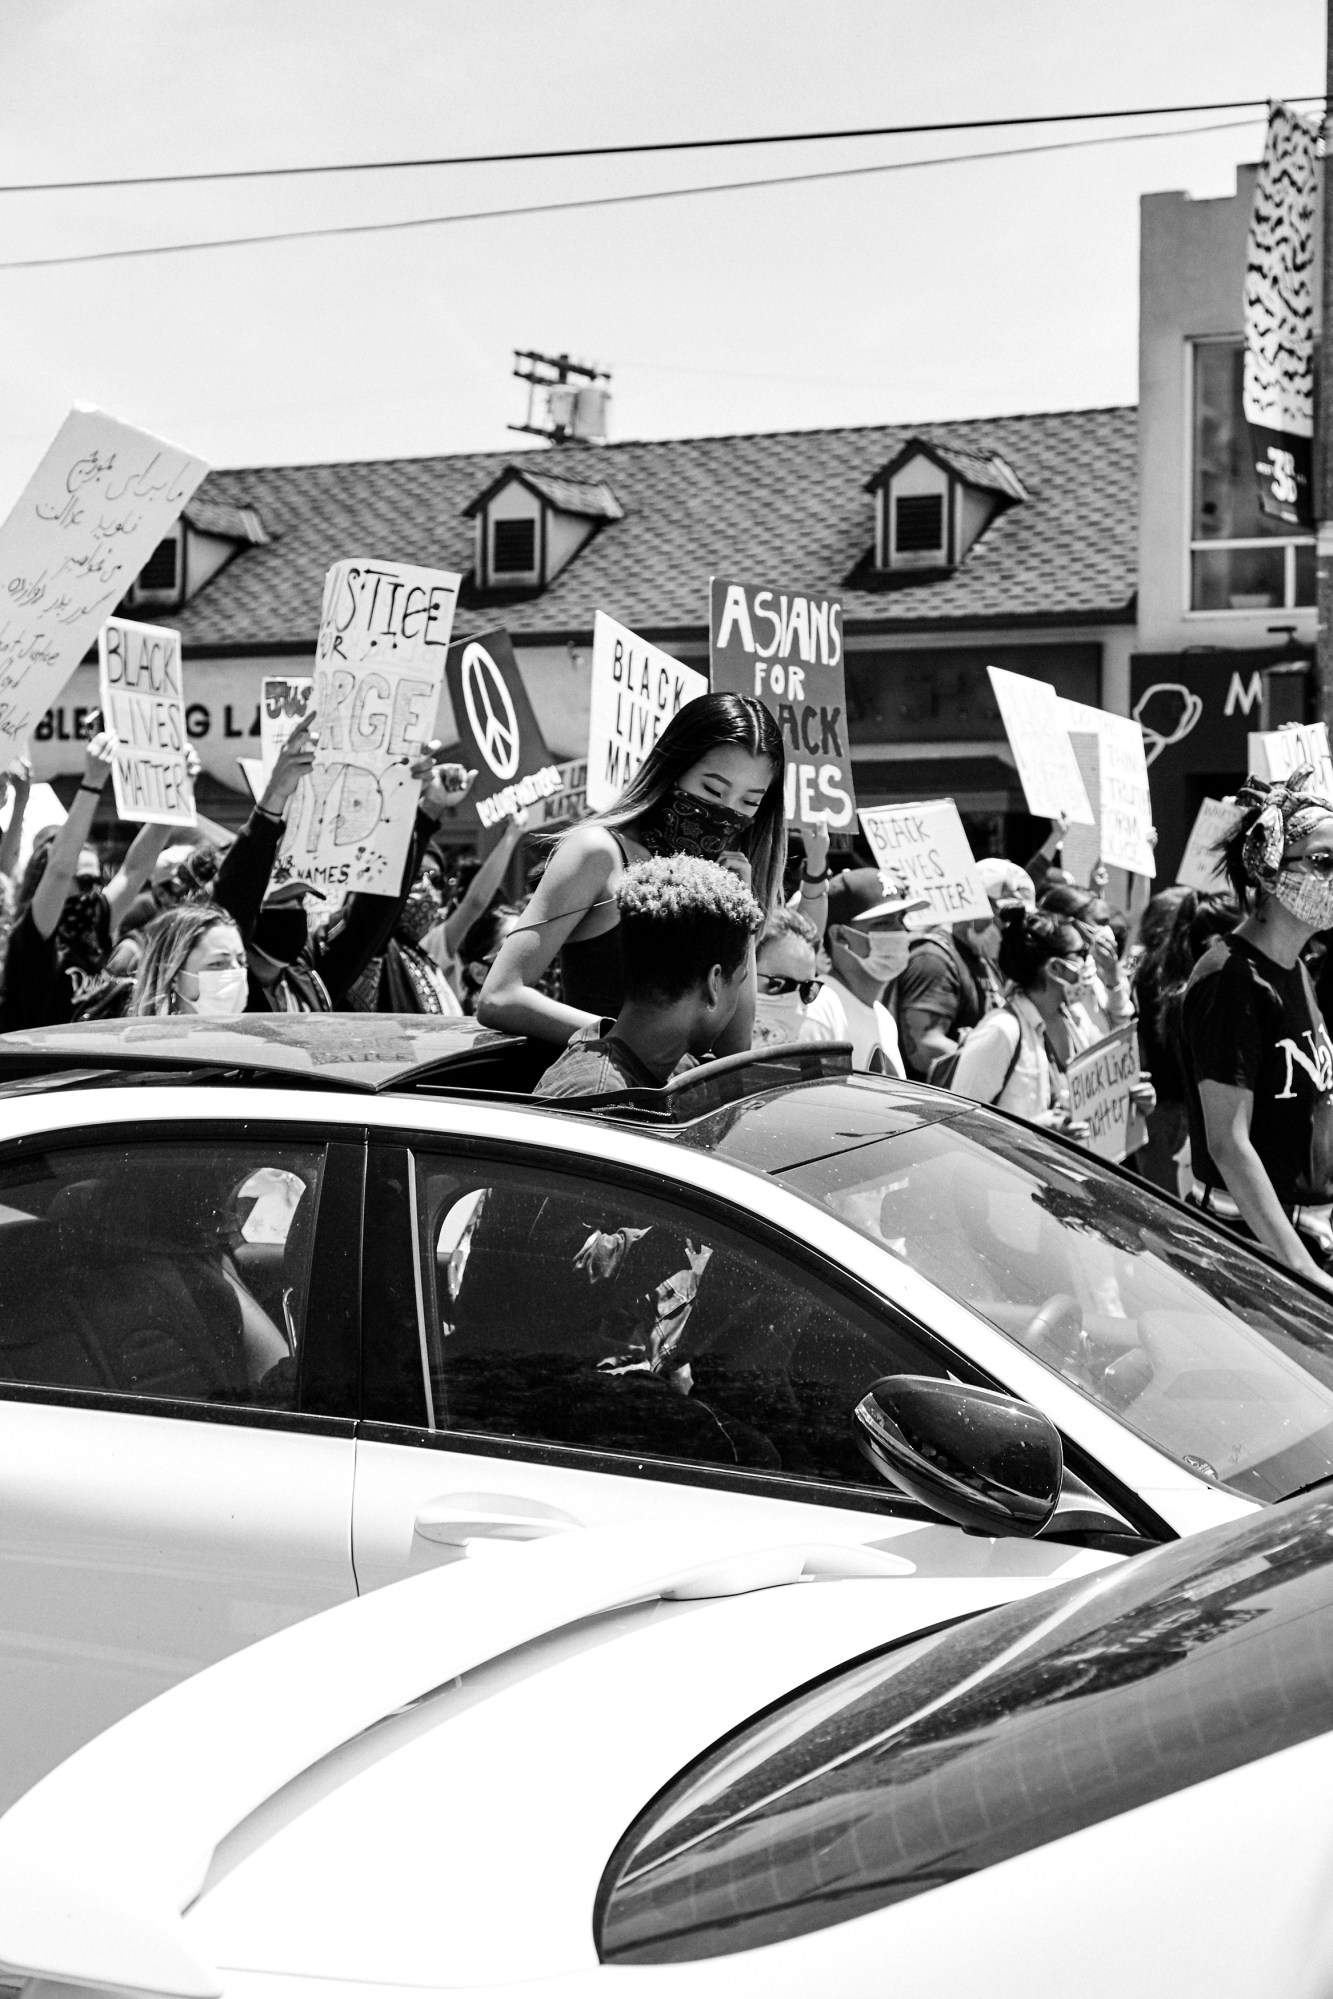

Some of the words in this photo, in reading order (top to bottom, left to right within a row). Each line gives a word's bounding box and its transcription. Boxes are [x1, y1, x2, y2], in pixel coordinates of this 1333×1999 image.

[319, 631, 348, 661] OR
[716, 585, 842, 667] ASIANS
[107, 627, 179, 696] BLACK
[613, 639, 686, 716] BLACK
[754, 661, 806, 702] FOR
[110, 696, 181, 752] LIVES
[616, 691, 662, 751] LIVE
[777, 703, 844, 758] ACK
[118, 757, 191, 815] MATTER
[867, 815, 932, 851] BLACK
[897, 848, 945, 881] IVES
